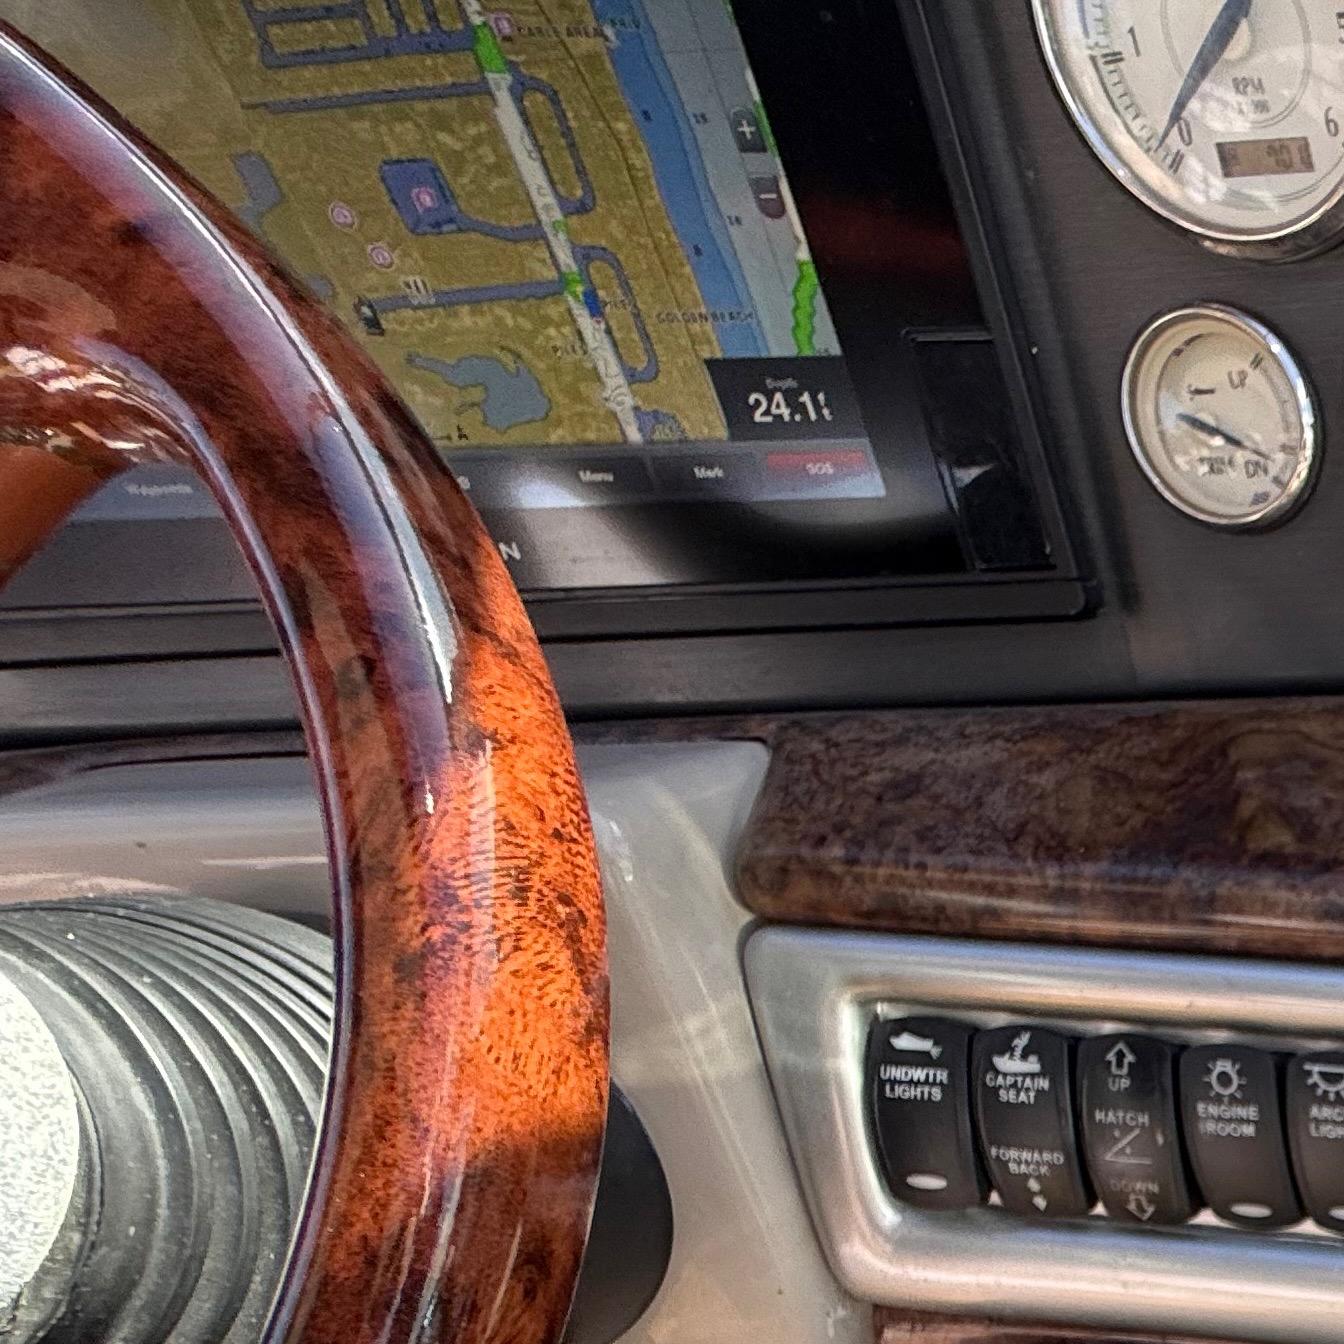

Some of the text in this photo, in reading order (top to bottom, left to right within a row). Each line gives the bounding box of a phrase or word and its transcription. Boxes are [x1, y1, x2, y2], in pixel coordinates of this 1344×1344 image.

[1127, 26, 1141, 57] 1
[1324, 106, 1339, 137] 6
[748, 391, 817, 423] 24.1
[805, 462, 835, 475] SOS
[880, 1063, 949, 1085] UNDWTR
[985, 1072, 1050, 1093] CAPTAIN
[1107, 1076, 1131, 1092] UP
[885, 1083, 943, 1103] LIGHTS
[998, 1087, 1037, 1106] SEAT
[1094, 1108, 1150, 1128] HATCH
[1196, 1102, 1261, 1122] ENGINE
[1199, 1120, 1258, 1139] ROOM
[990, 1145, 1065, 1166] FORWARD
[1008, 1160, 1051, 1177] BACK
[1107, 1178, 1160, 1196] DOWN
